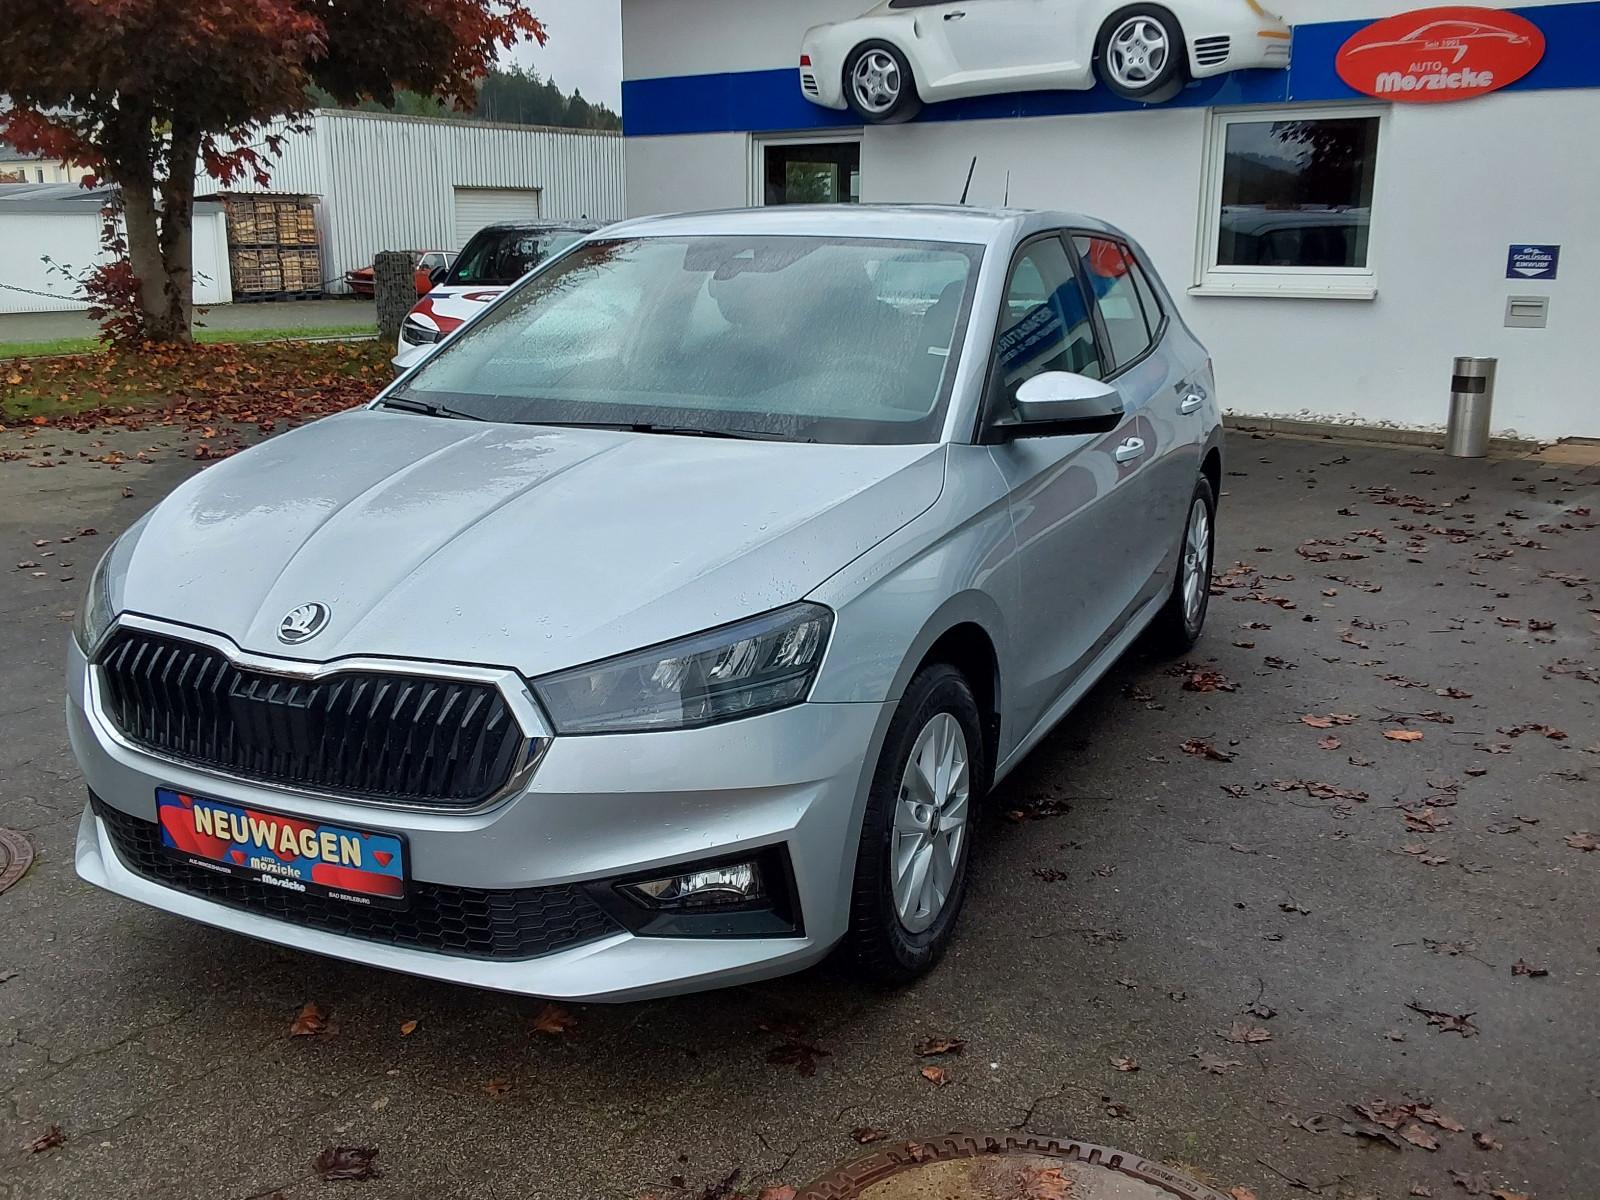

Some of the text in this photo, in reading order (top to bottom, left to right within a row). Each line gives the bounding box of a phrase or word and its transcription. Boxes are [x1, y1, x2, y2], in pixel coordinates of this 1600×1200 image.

[1408, 61, 1442, 73] AUTO
[1375, 67, 1494, 93] Moszicke
[193, 804, 362, 867] NEUWAGEN
[250, 856, 301, 878] Moszicke
[260, 855, 275, 864] AUTO
[262, 873, 306, 892] Moszicke
